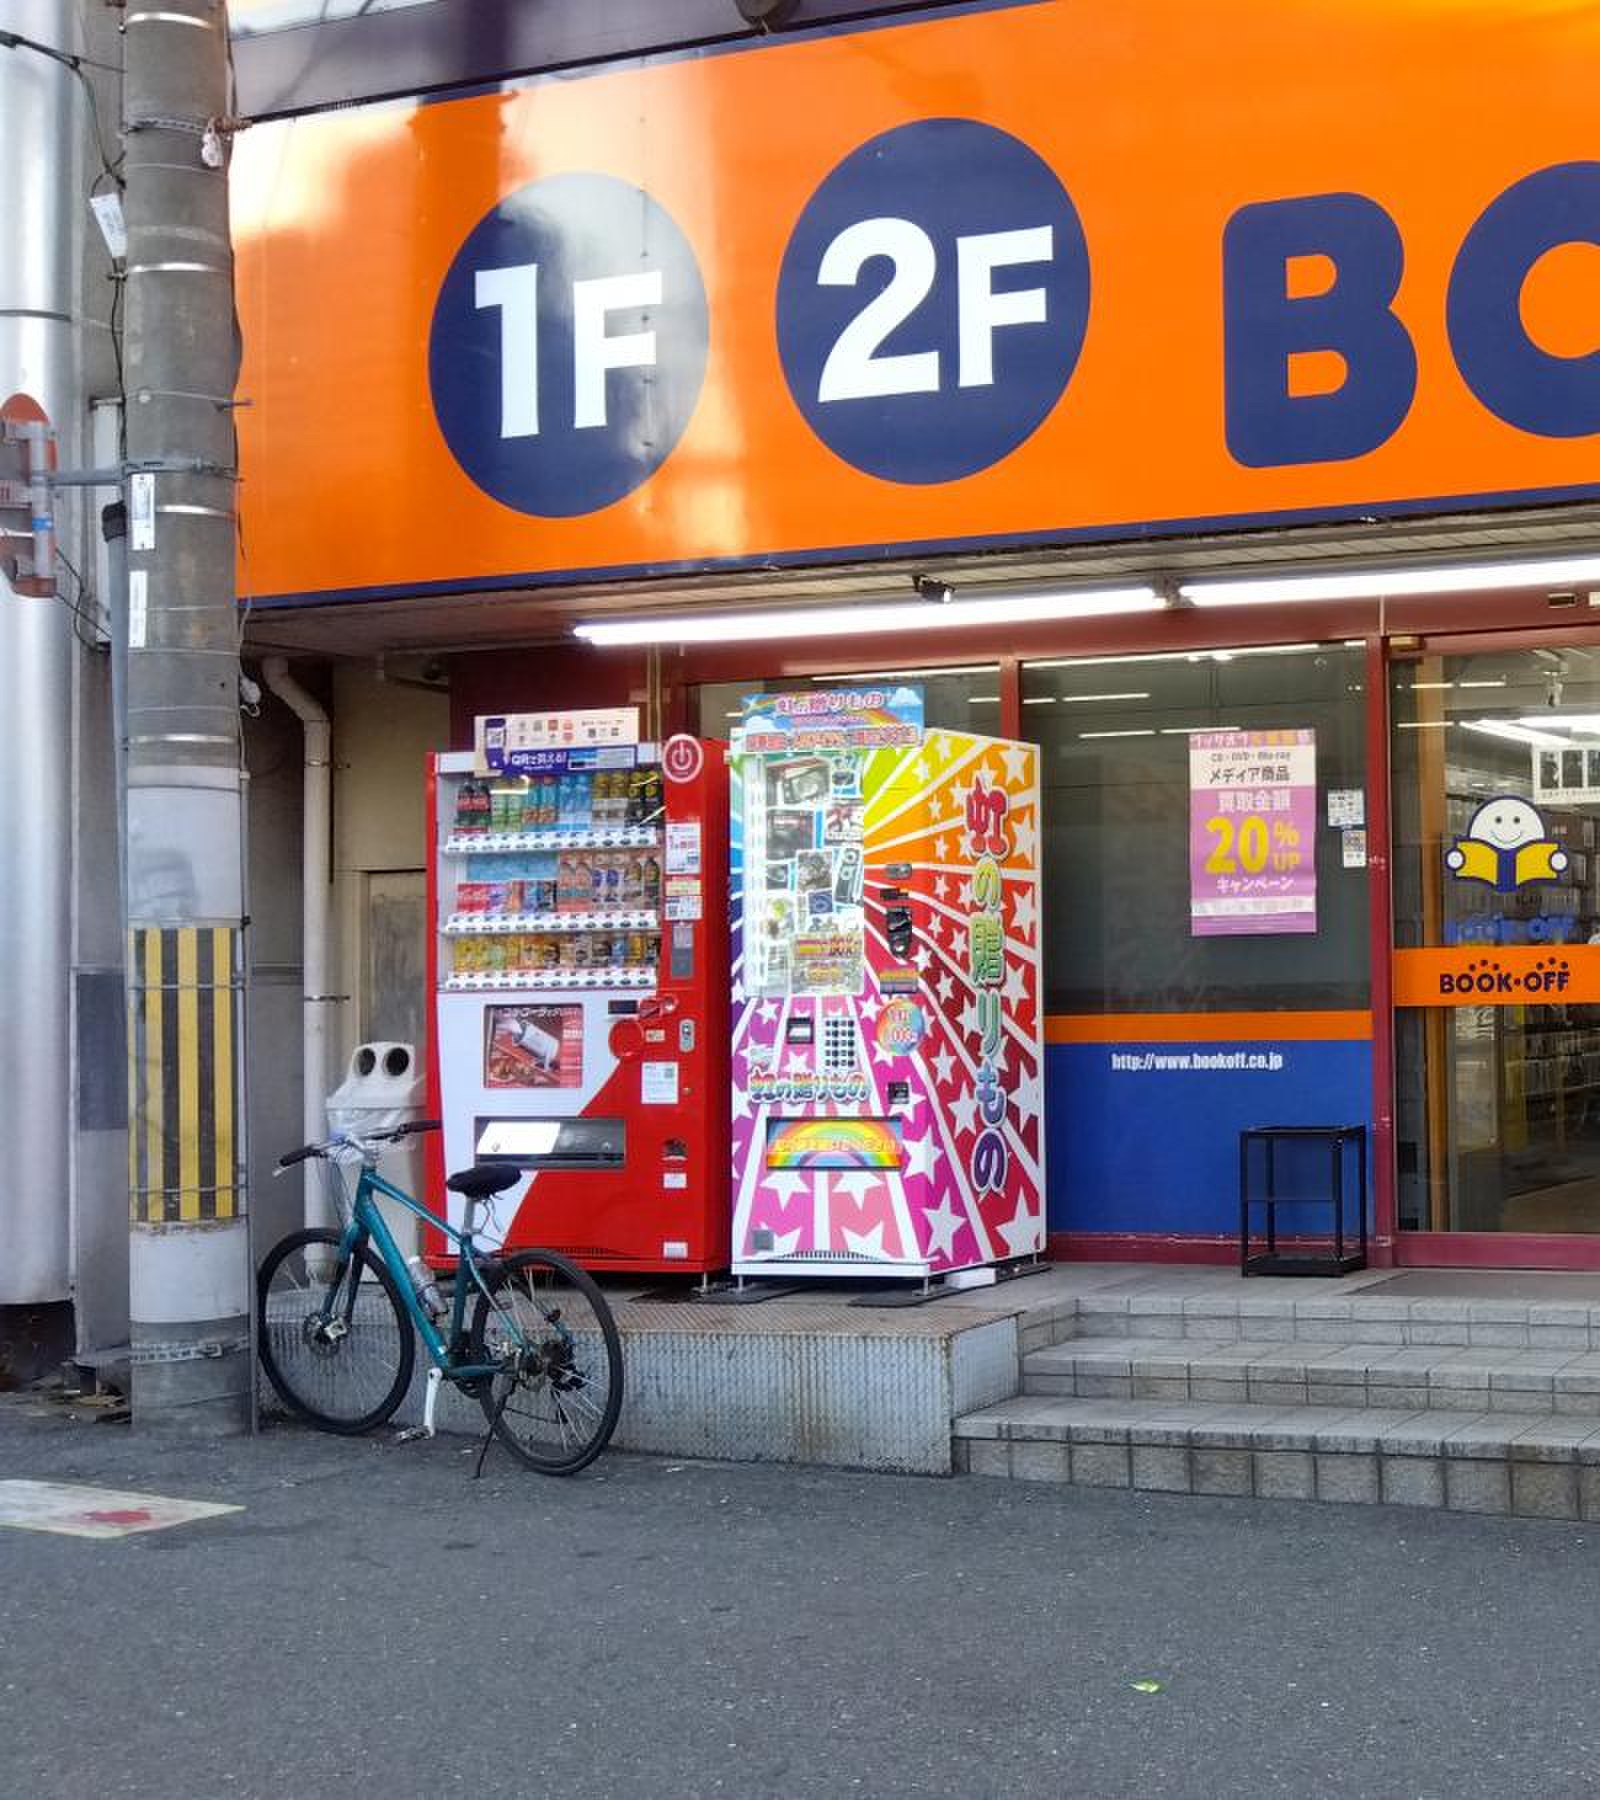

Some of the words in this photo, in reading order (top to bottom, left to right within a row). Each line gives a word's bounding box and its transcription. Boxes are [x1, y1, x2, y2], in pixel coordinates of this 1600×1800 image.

[816, 217, 1055, 402] 2F
[473, 264, 663, 438] 1F
[1209, 765, 1291, 784] メディア商品
[1216, 877, 1295, 894] キャンペーン
[1111, 1052, 1284, 1071] http://www.bookoff.co.jp
